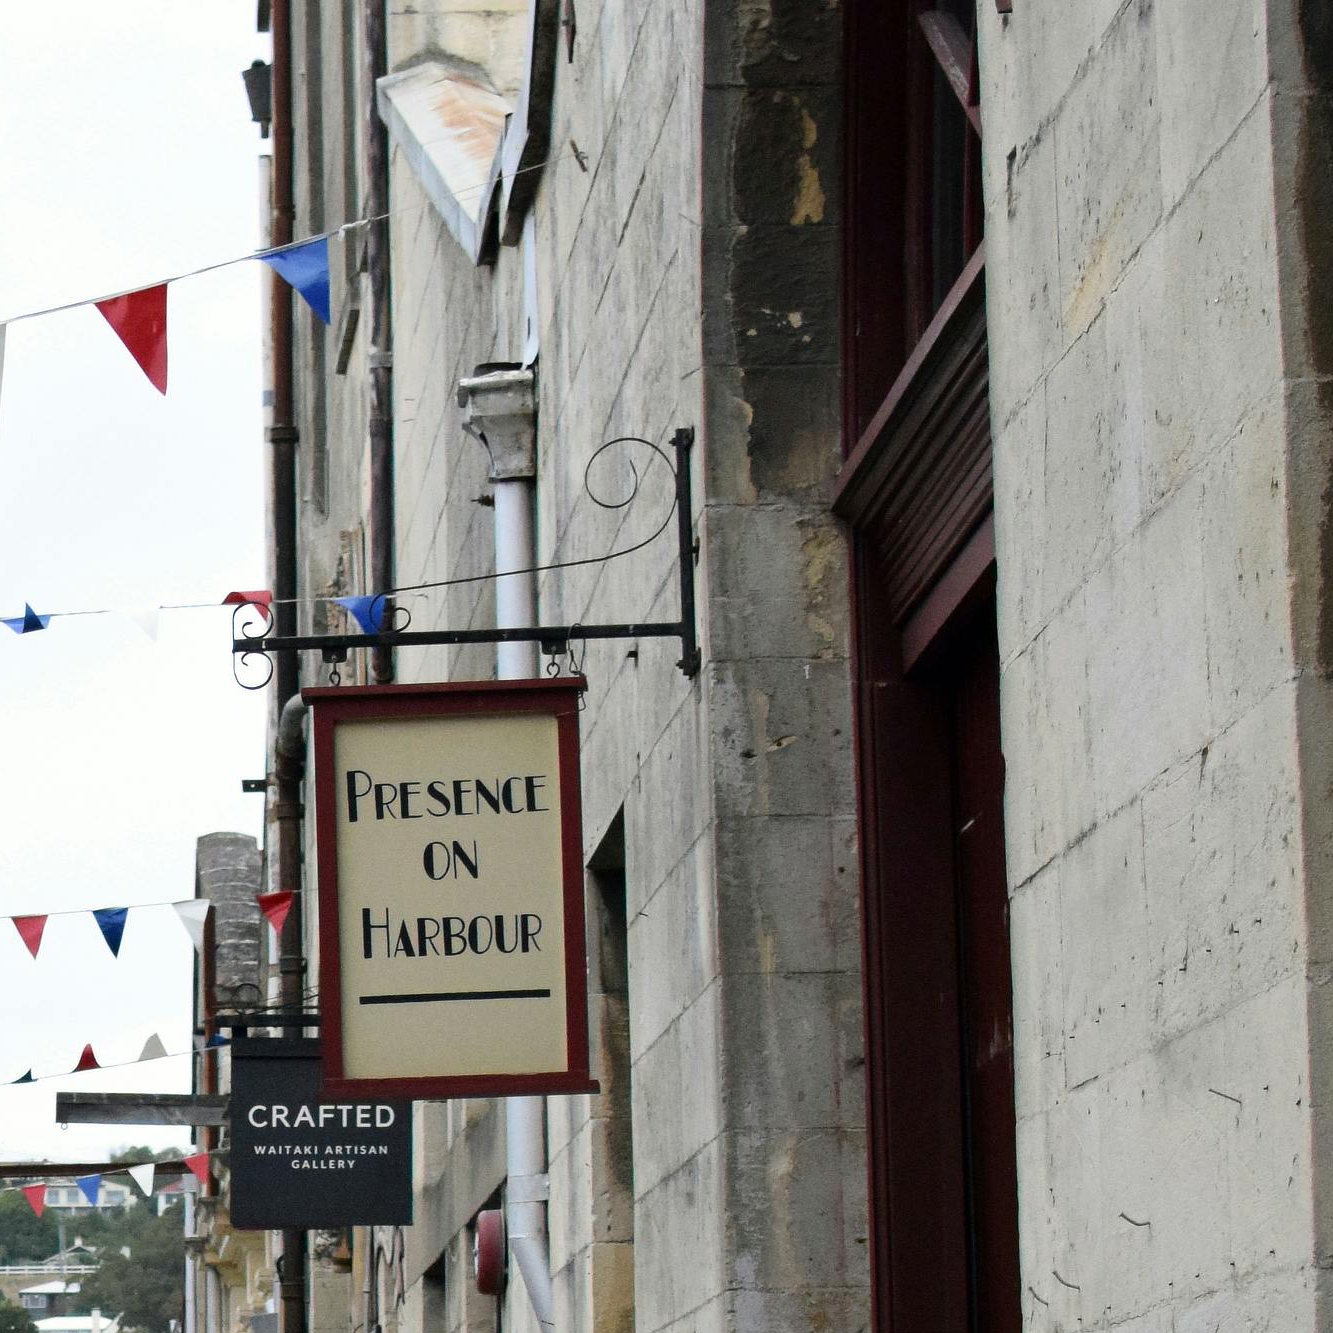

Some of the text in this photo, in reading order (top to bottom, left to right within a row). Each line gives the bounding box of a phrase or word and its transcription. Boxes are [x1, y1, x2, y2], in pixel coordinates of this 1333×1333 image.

[346, 769, 550, 823] PRESENCE
[422, 839, 479, 881] ON
[361, 906, 543, 960] HARBOUR
[247, 1104, 396, 1129] CRAFTED
[253, 1145, 389, 1155] WAITAKI ARTISAN
[291, 1159, 356, 1169] GALLERY
